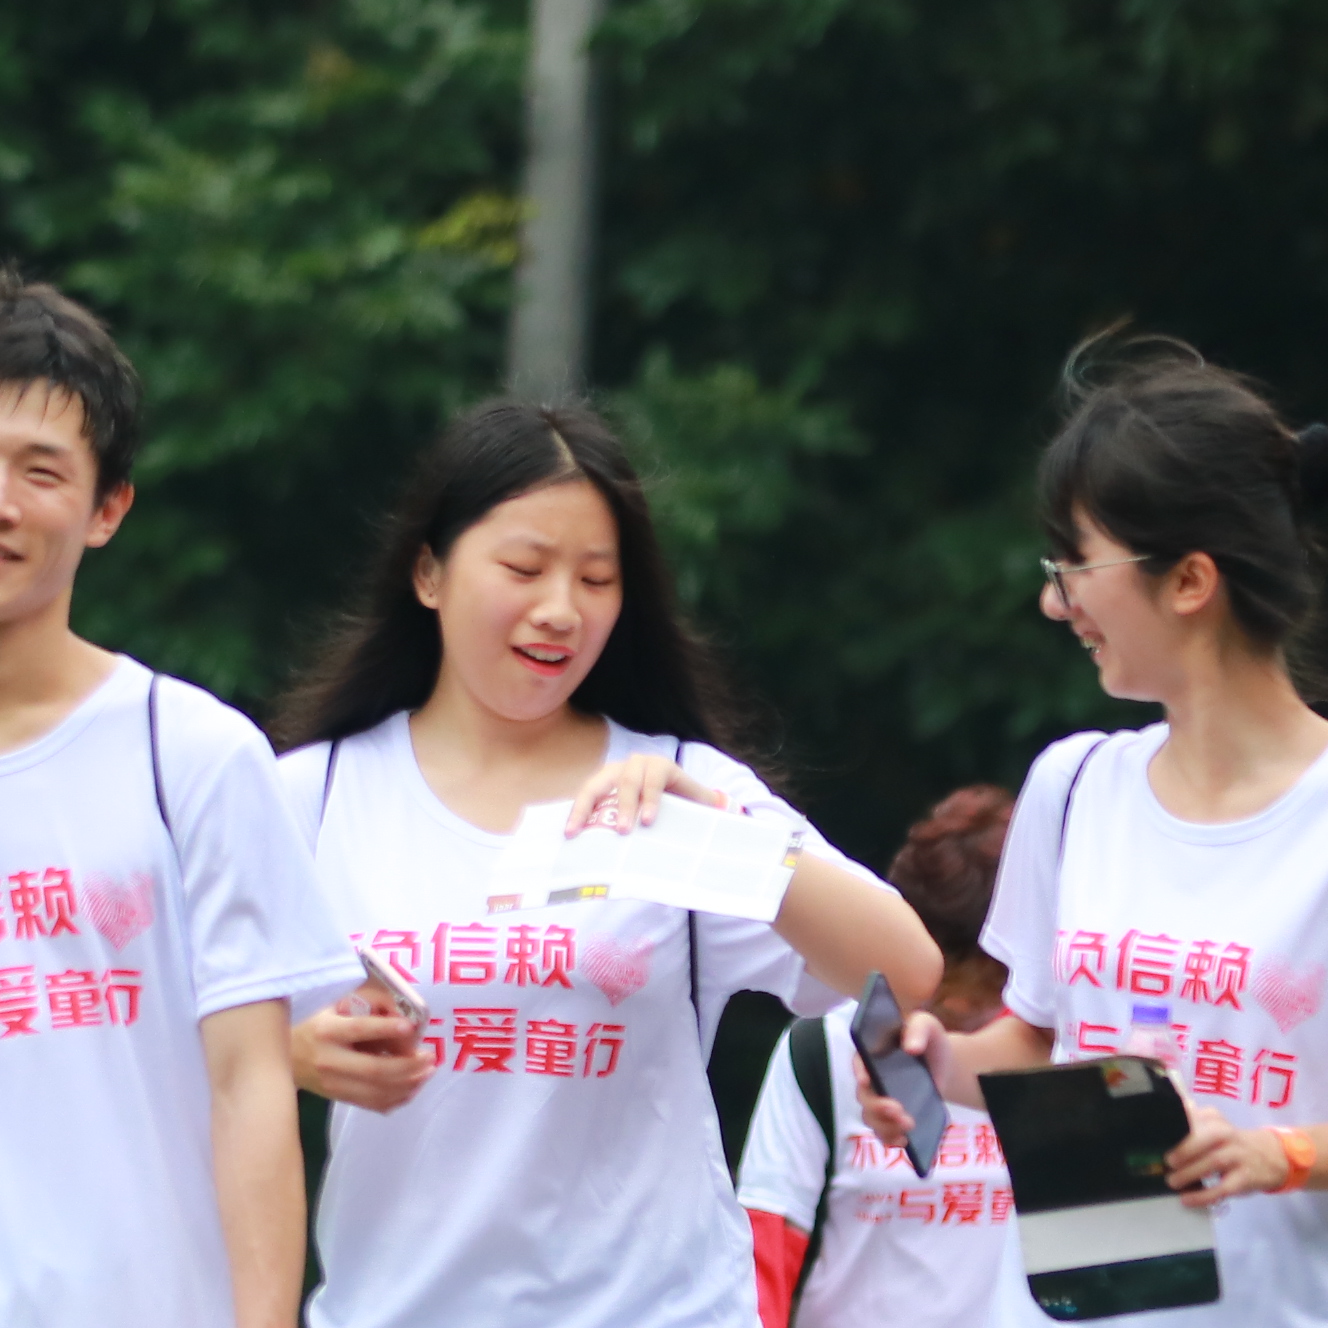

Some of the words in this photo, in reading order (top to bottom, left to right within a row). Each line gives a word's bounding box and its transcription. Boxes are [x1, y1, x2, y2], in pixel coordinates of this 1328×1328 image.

[349, 922, 576, 988] 负信赖
[1078, 1022, 1298, 1109] 与童行
